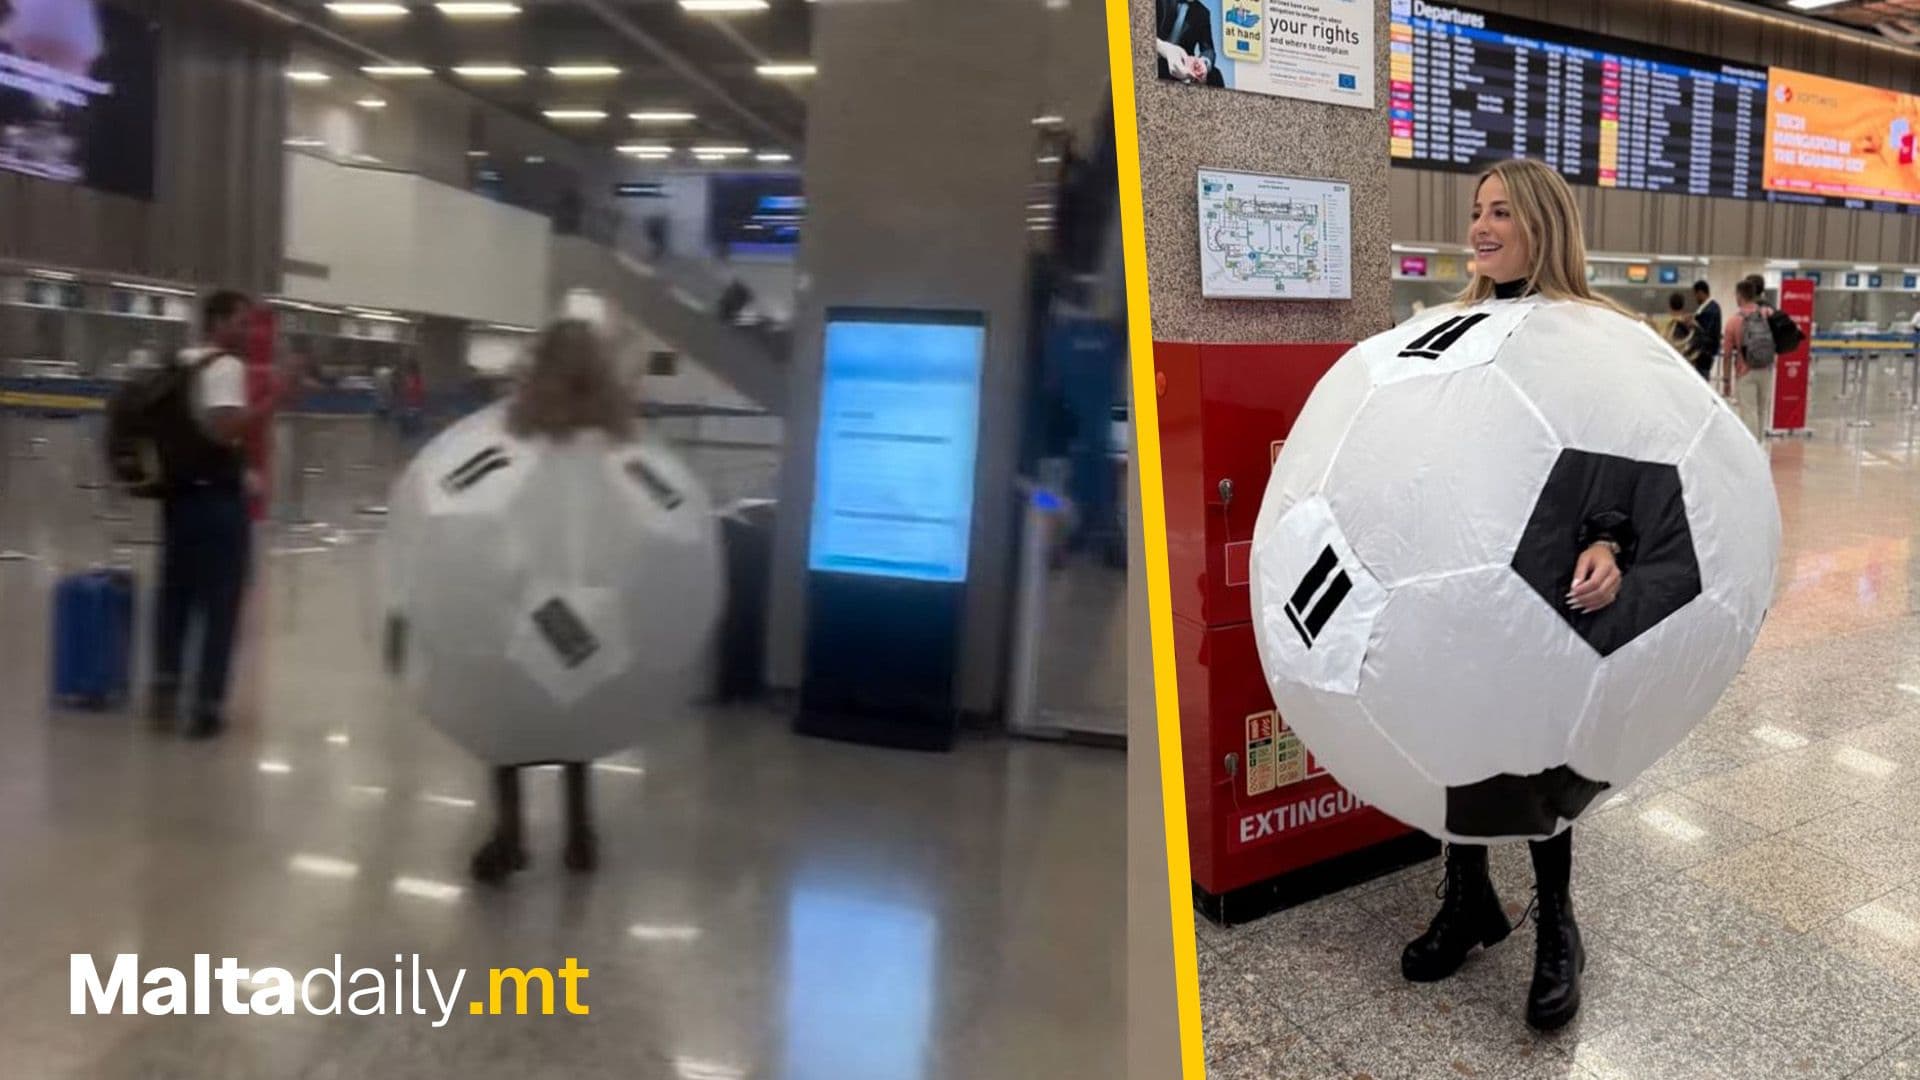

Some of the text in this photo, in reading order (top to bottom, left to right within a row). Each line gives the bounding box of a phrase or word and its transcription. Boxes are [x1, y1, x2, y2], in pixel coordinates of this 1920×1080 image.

[1413, 1, 1485, 29] Departures
[1225, 27, 1261, 41] at hand
[1269, 17, 1360, 45] your rights
[1270, 37, 1284, 45] and
[1285, 39, 1307, 49] where
[1309, 42, 1316, 50] to
[1317, 45, 1350, 56] complain
